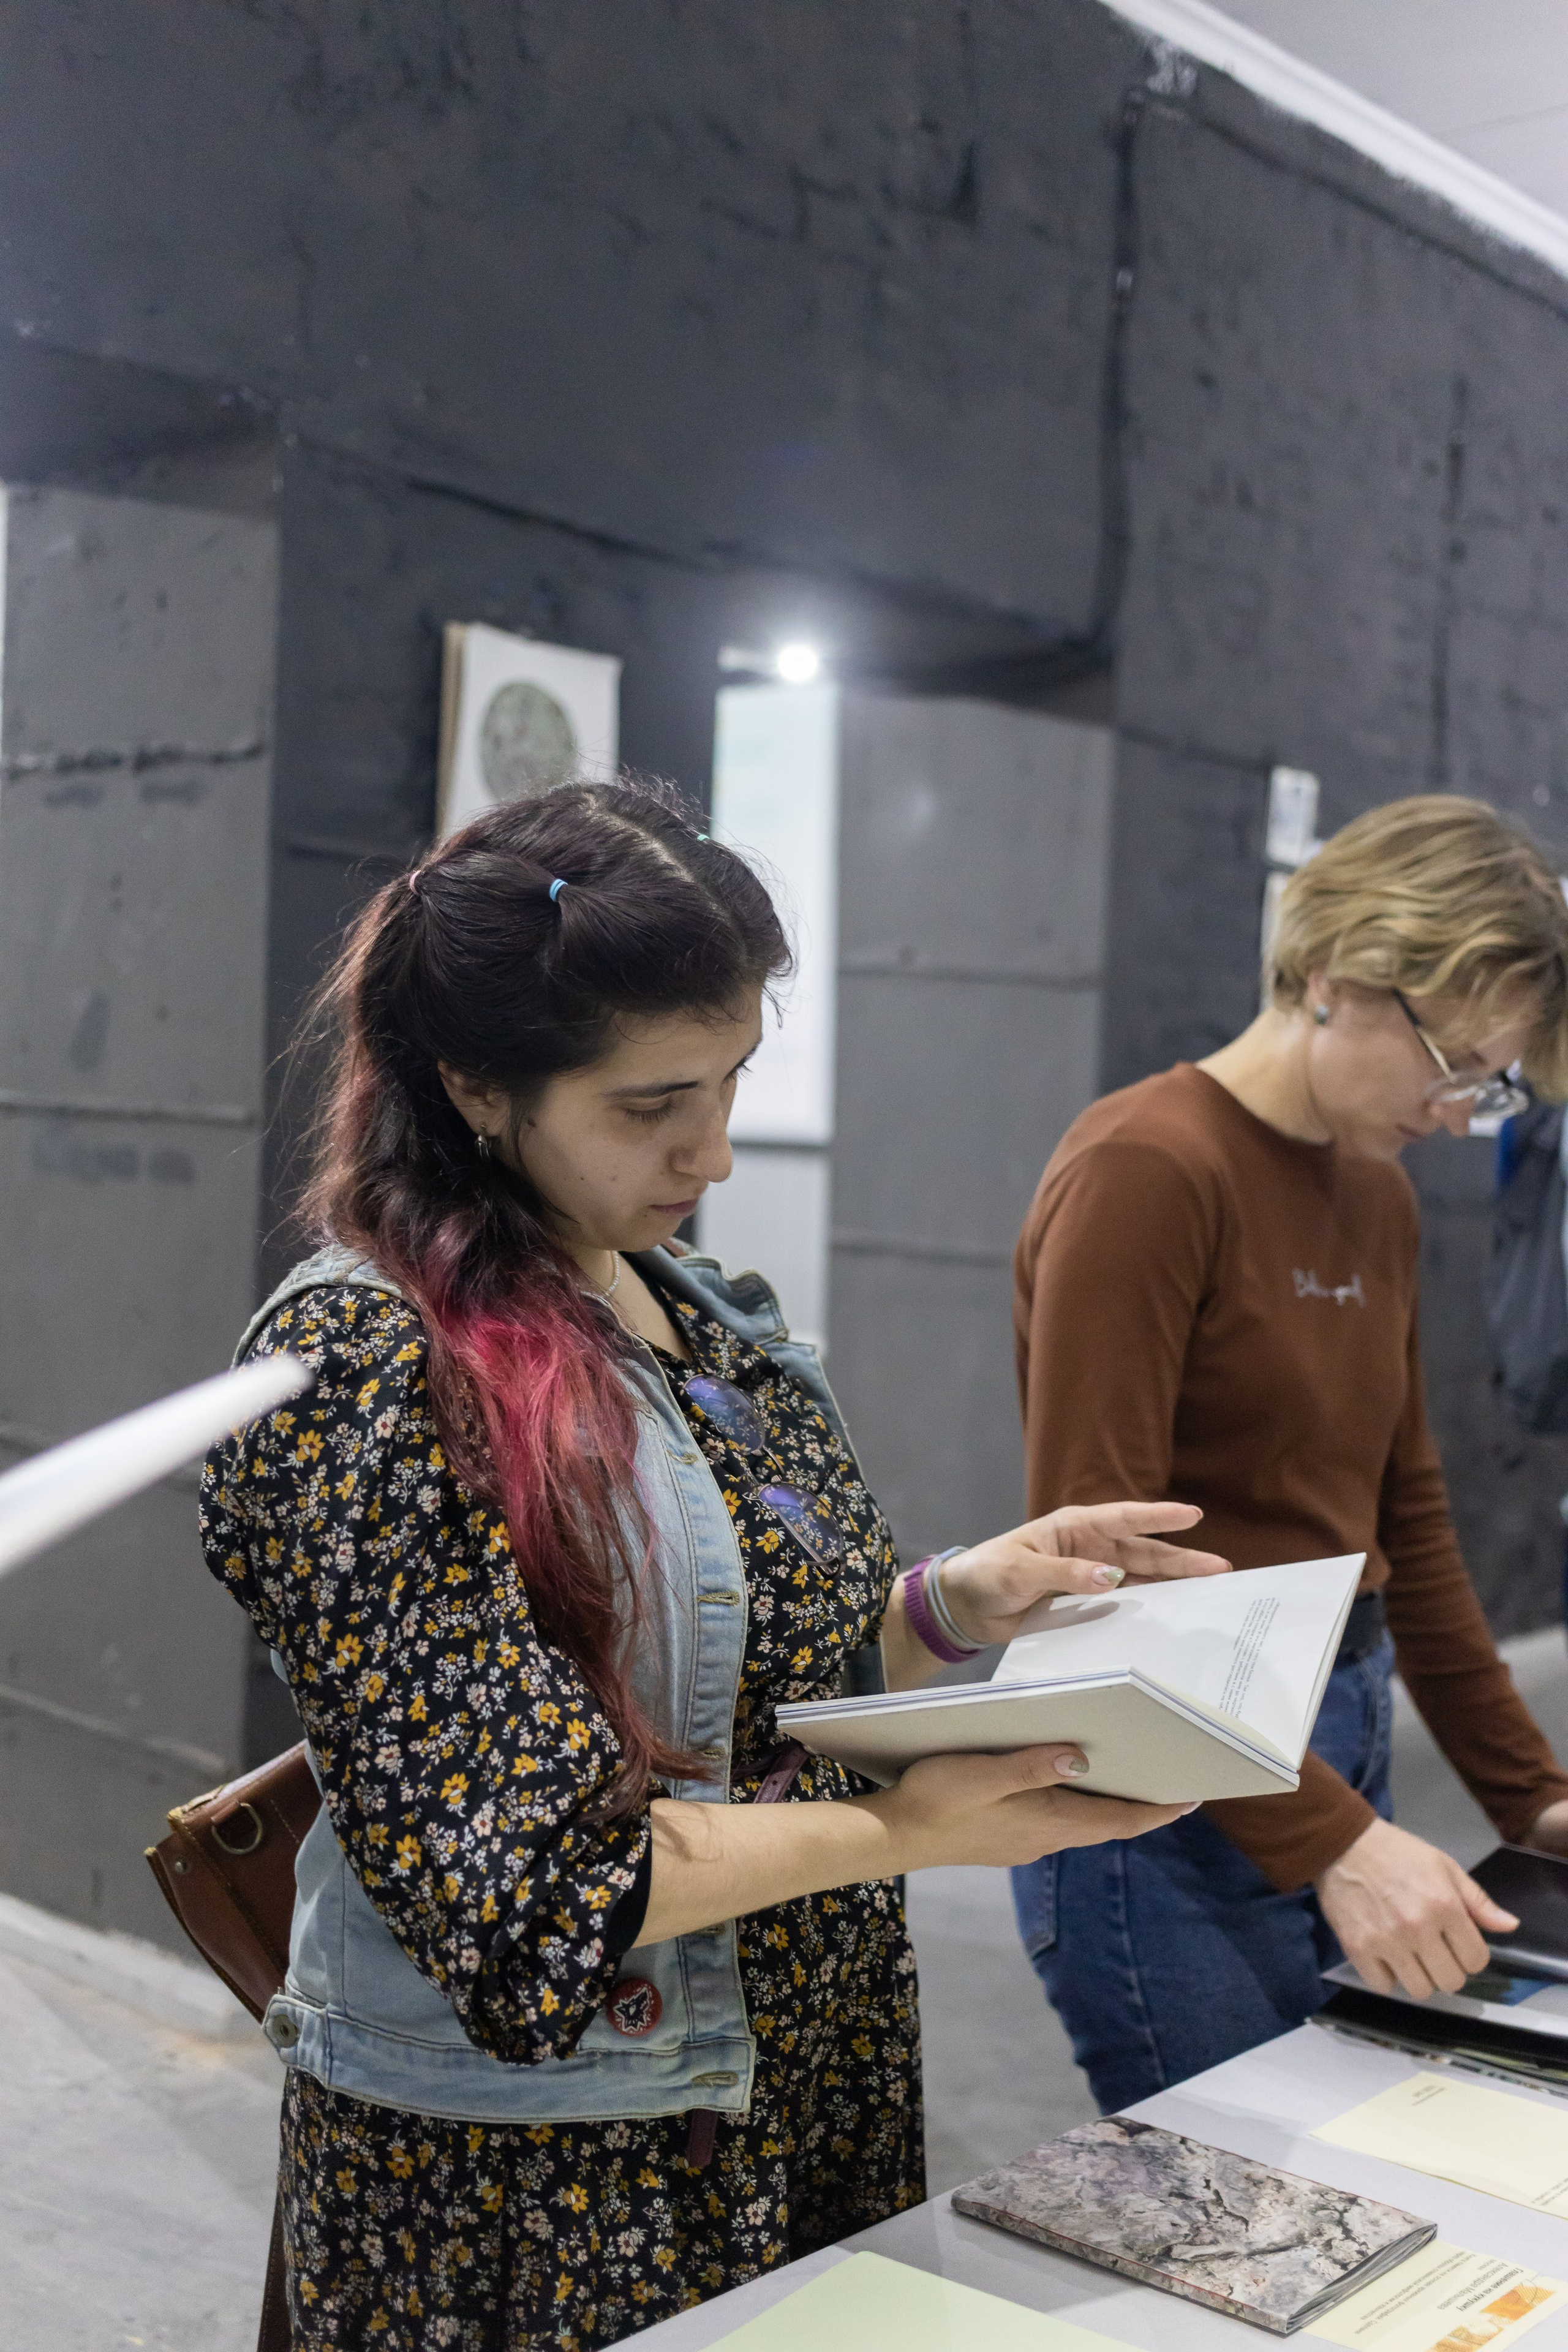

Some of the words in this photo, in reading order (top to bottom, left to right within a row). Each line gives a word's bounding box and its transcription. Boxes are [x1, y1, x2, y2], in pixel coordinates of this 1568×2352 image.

[1466, 2261, 1510, 2288] Александра
[1488, 2267, 1524, 2290] Глашение
[1434, 2286, 1476, 2311] Малышева
[1452, 2292, 1486, 2312] кукушку
